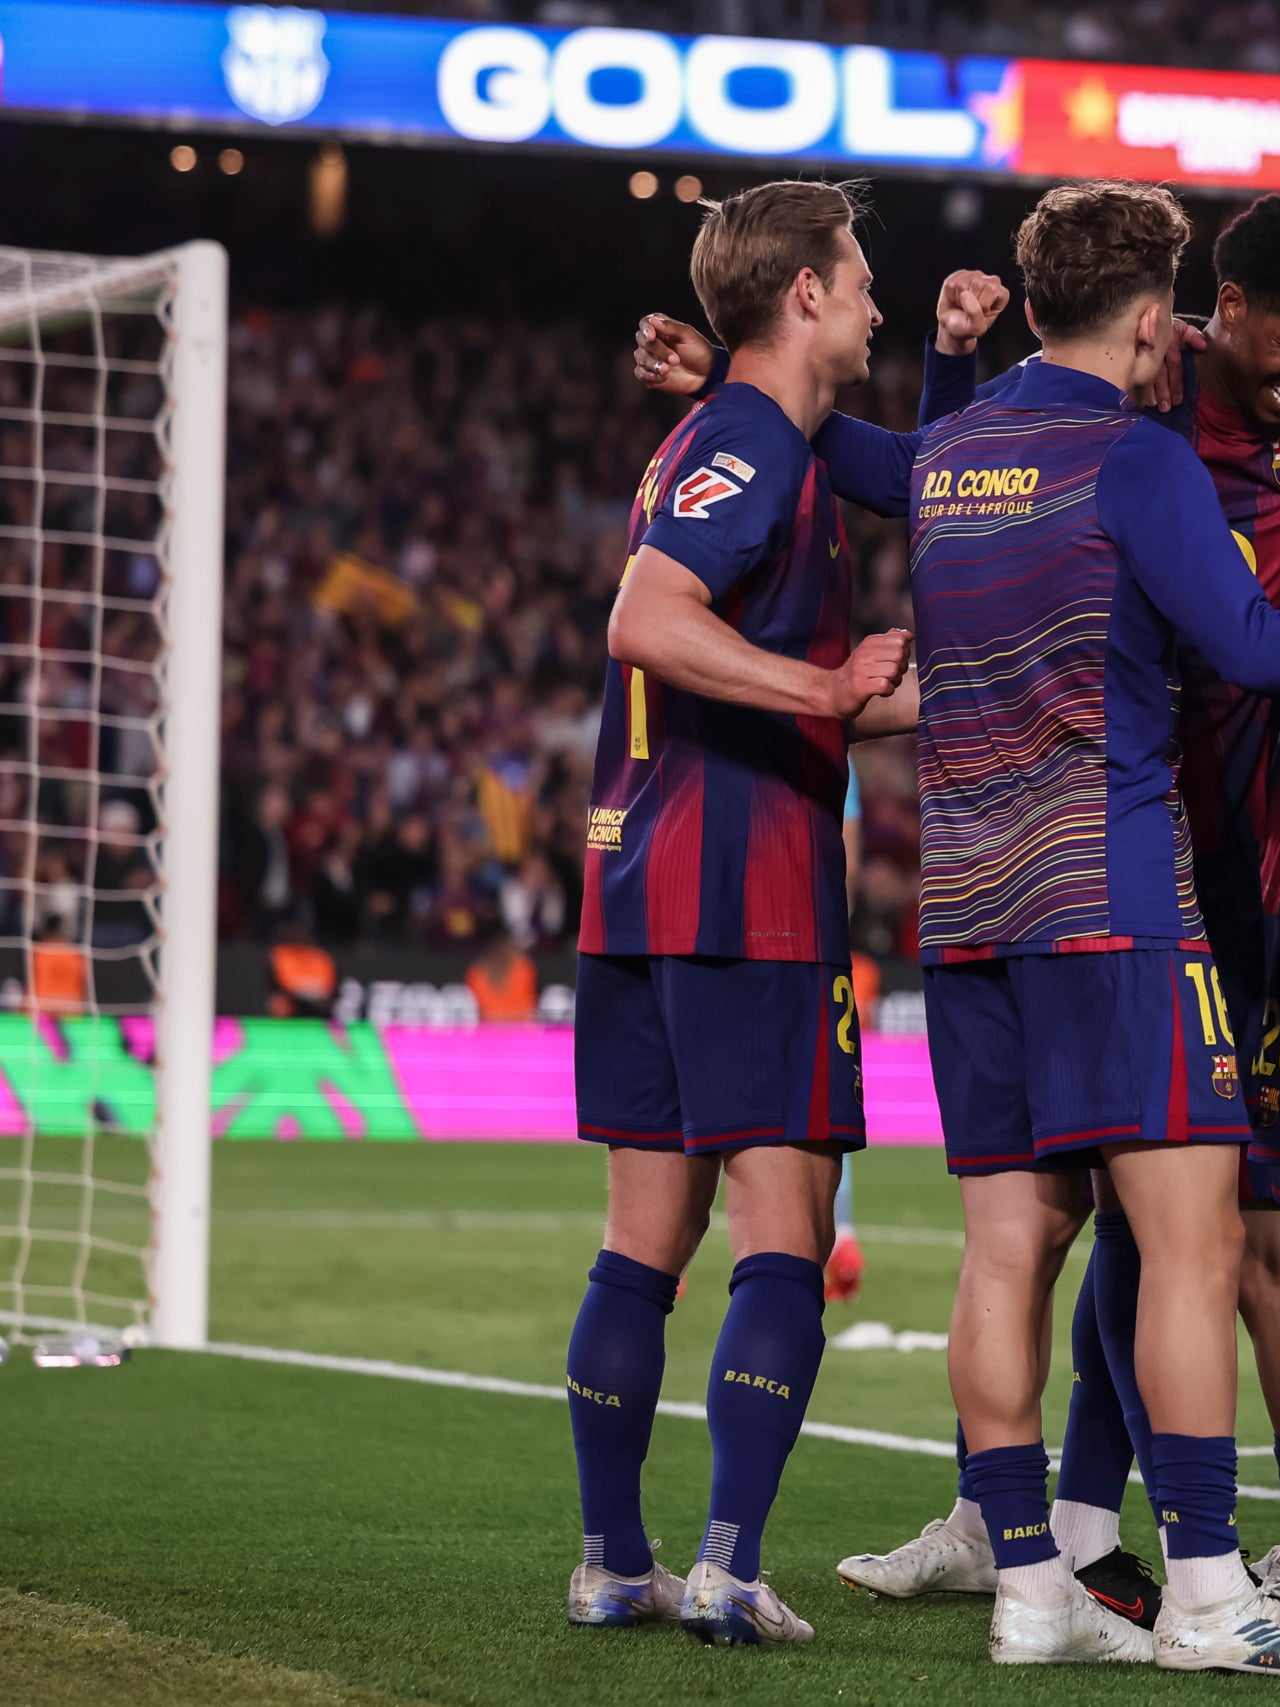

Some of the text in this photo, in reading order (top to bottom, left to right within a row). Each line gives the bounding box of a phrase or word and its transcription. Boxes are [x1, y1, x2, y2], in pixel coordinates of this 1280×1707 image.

[437, 26, 978, 160] GOOL
[921, 467, 1040, 500] R.D. CONGO
[947, 503, 963, 516] DE
[966, 501, 1034, 515] L'AFRIQUE
[587, 824, 622, 843] ACNUR
